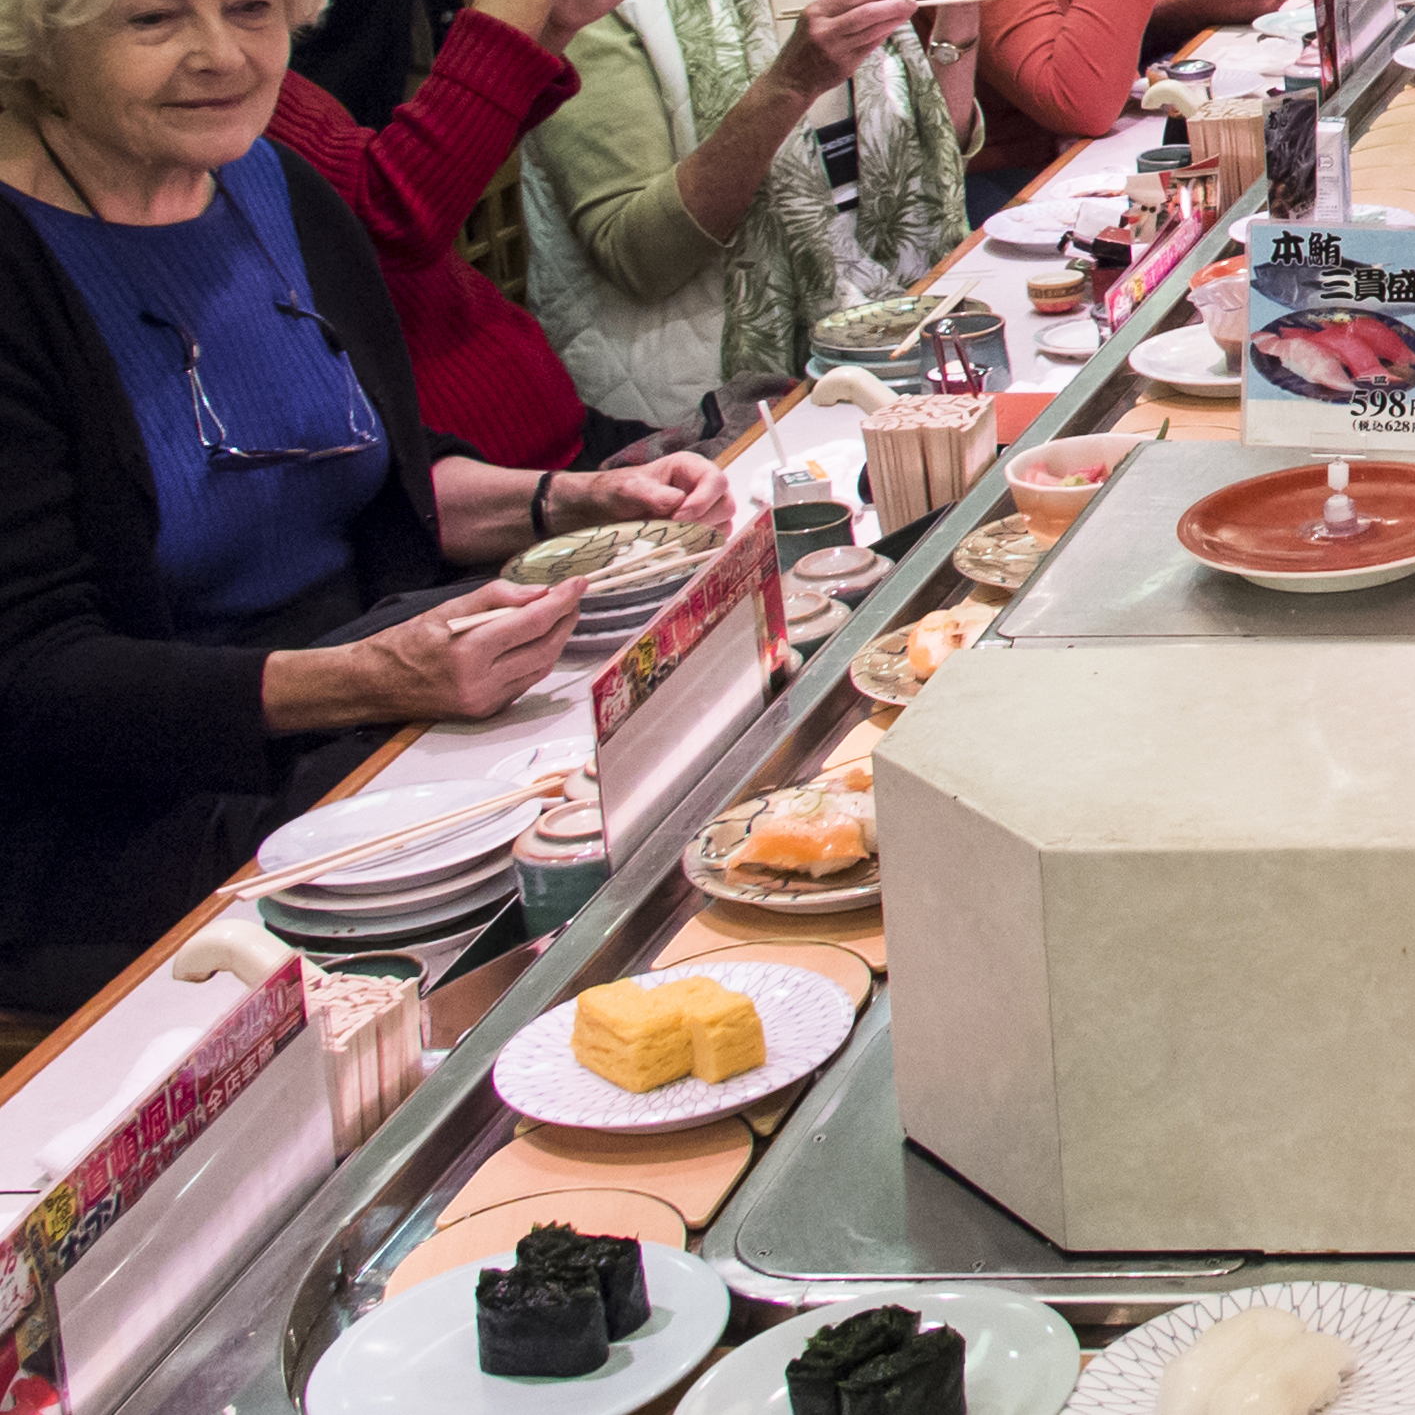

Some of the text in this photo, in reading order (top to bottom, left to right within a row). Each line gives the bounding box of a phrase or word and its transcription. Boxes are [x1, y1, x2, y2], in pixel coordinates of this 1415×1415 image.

[1270, 230, 1342, 267] 本鮪
[205, 1036, 276, 1116] 全店実施
